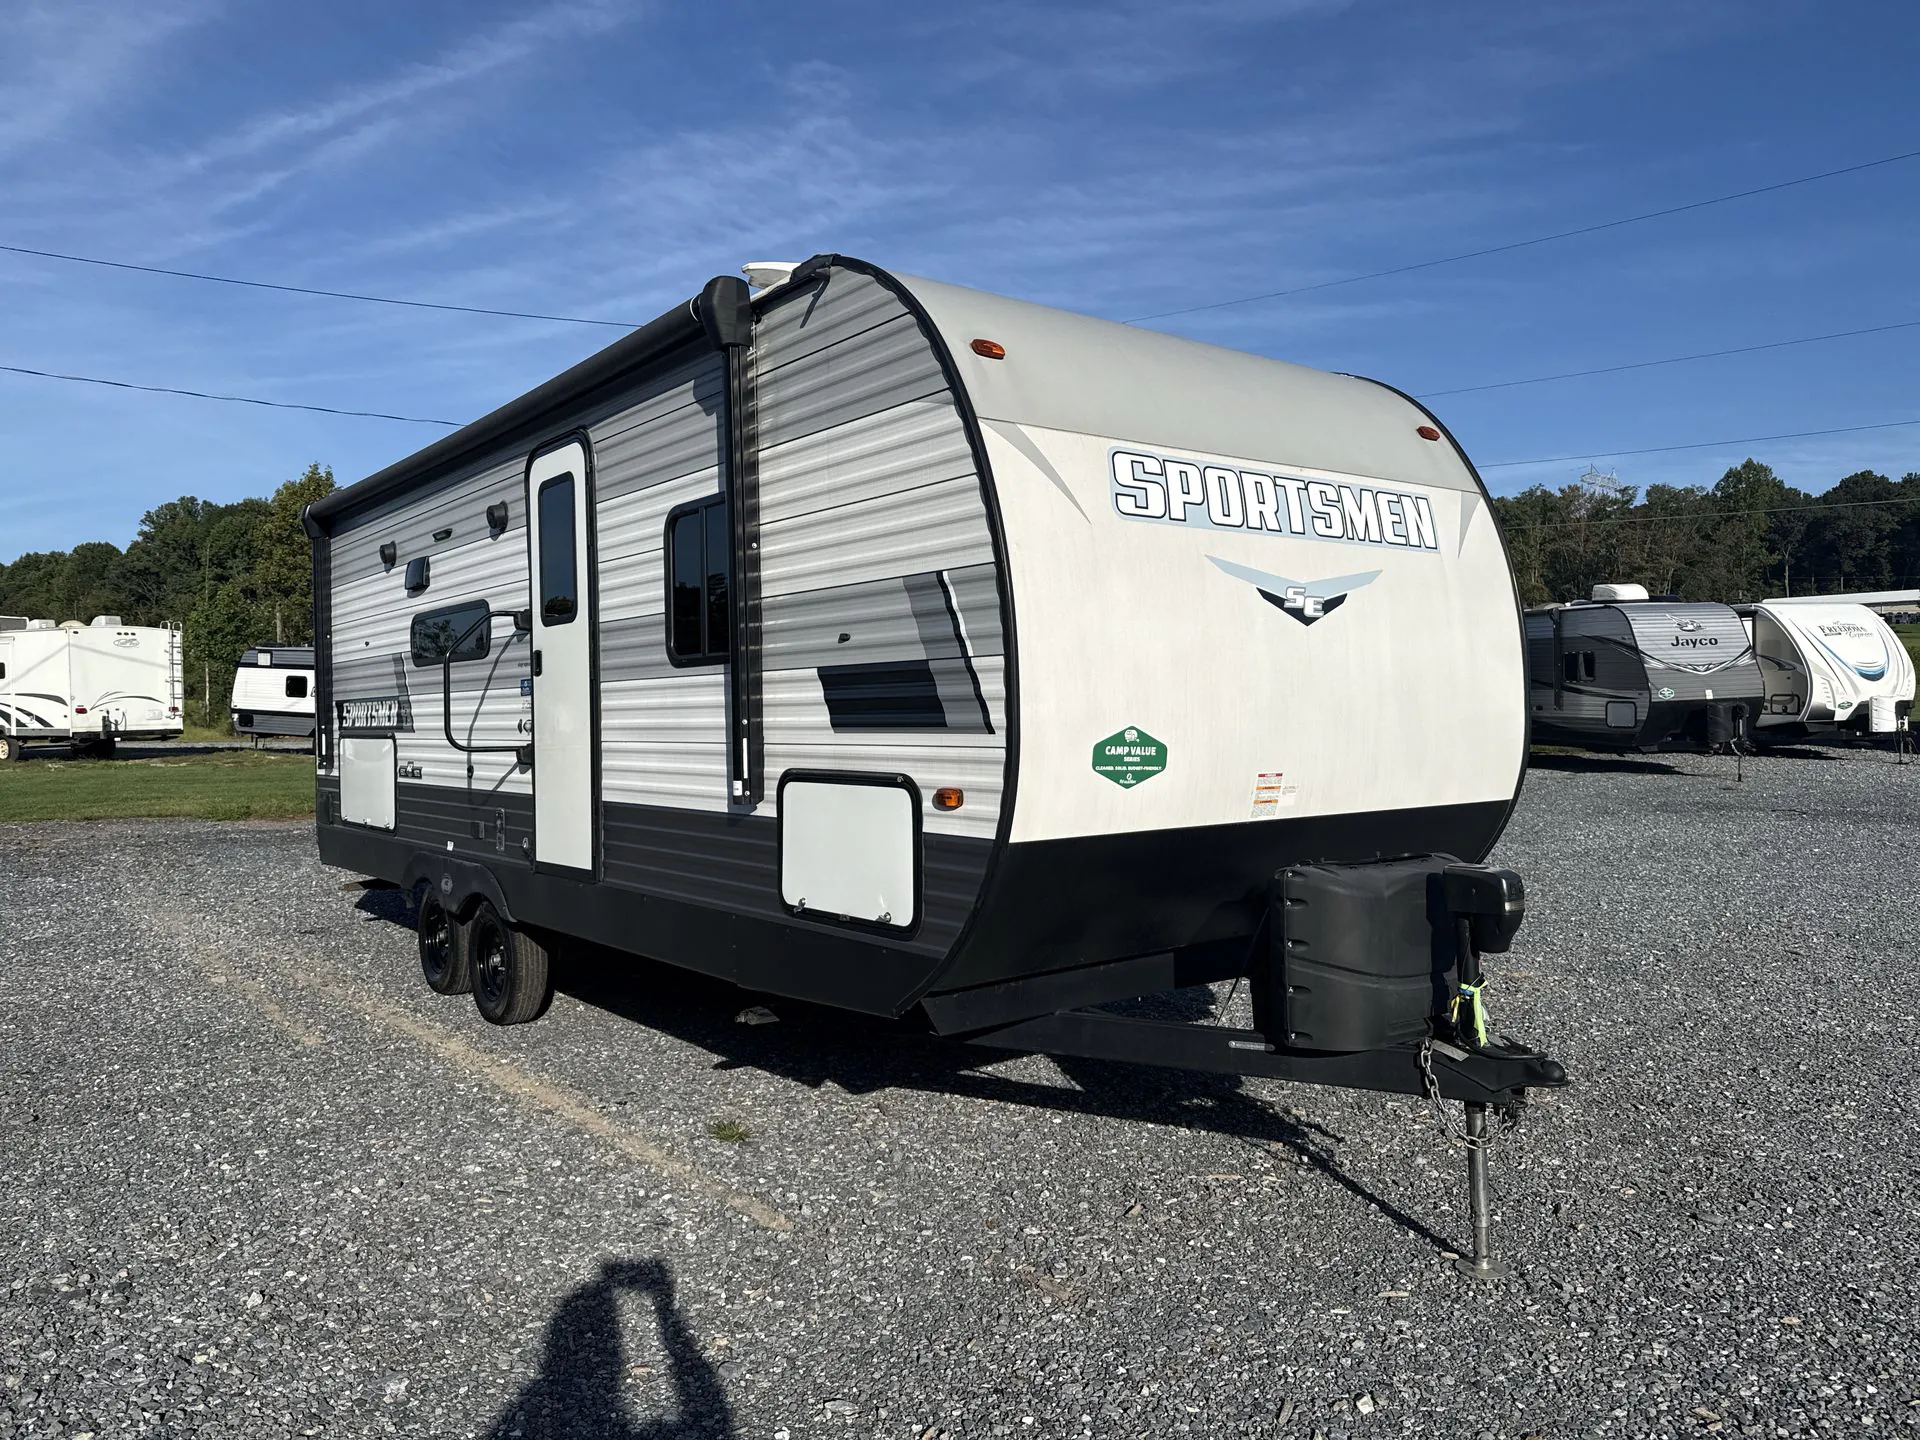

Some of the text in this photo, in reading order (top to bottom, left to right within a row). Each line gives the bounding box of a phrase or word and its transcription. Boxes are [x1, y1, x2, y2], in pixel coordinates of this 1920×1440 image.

[1111, 450, 1438, 550] SPORTSMEN
[1284, 586, 1324, 618] SE
[1670, 636, 1719, 648] Jayco
[342, 701, 399, 727] SPORTSMEN
[1105, 746, 1156, 755] CAMP VALUE
